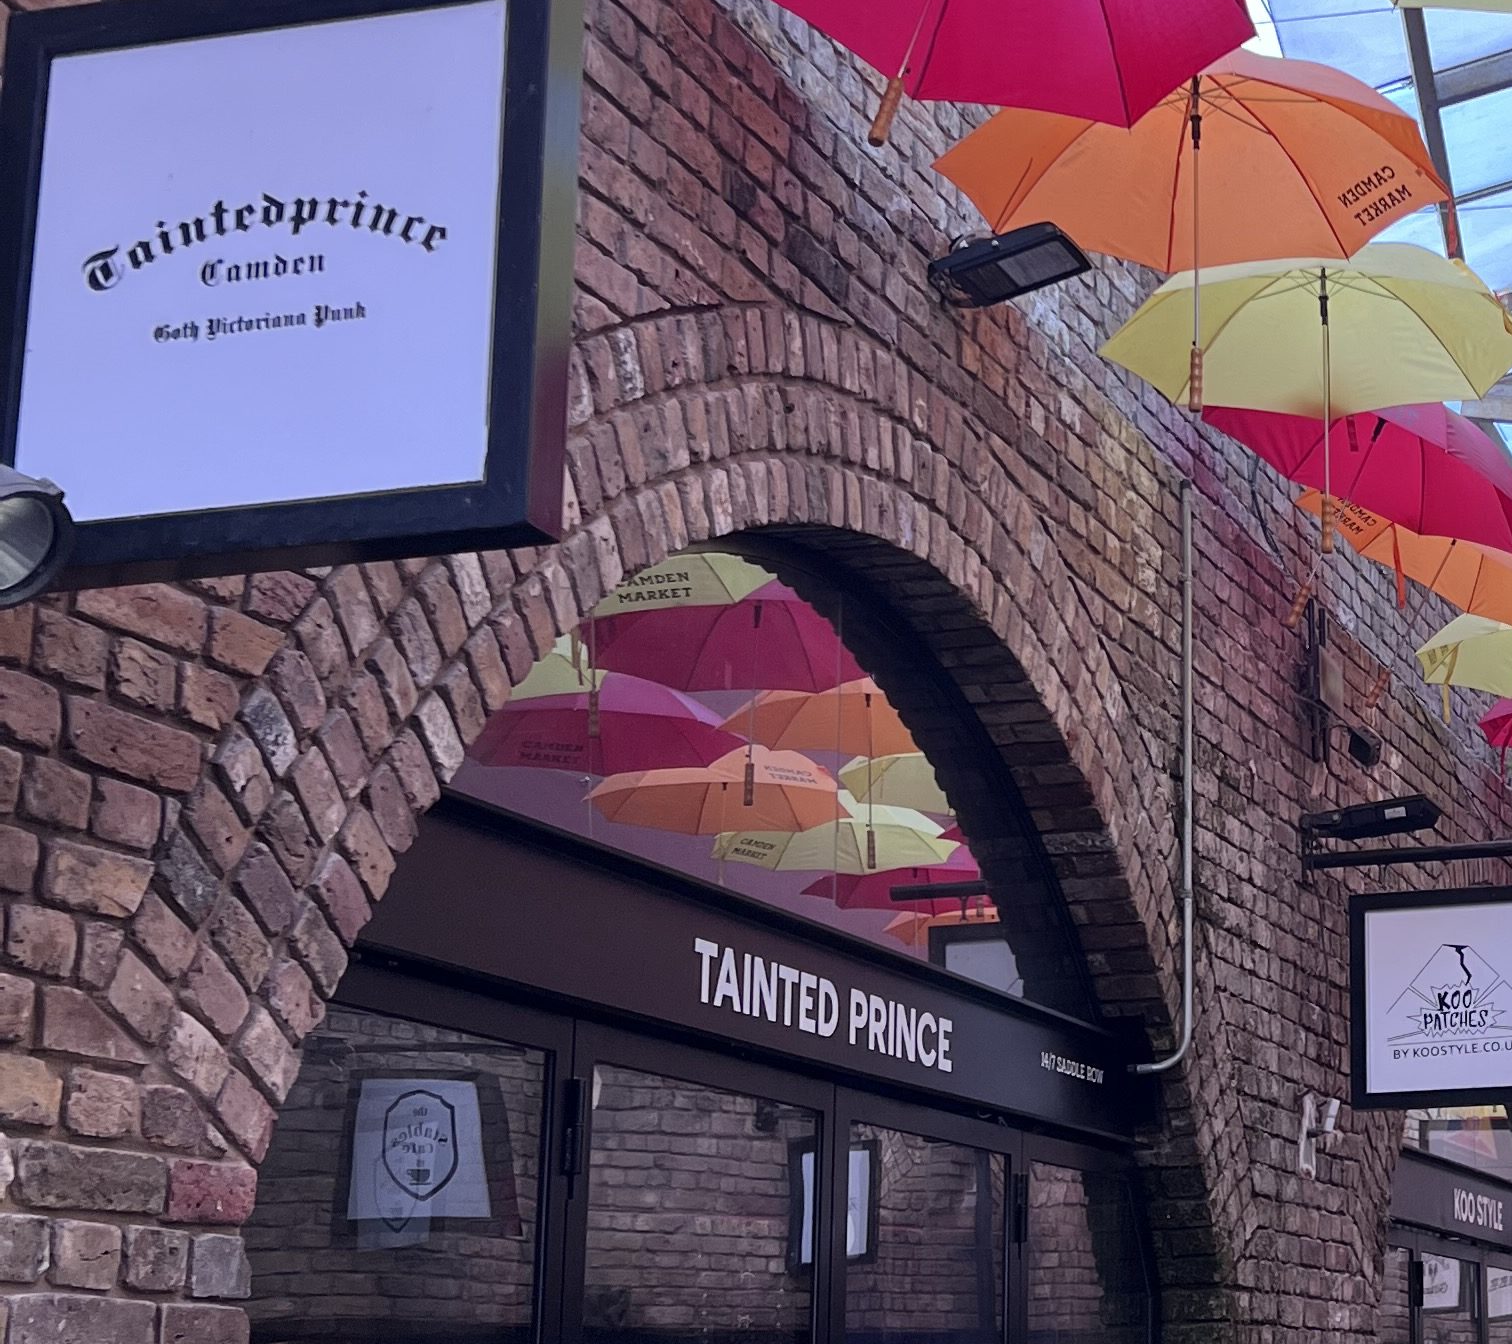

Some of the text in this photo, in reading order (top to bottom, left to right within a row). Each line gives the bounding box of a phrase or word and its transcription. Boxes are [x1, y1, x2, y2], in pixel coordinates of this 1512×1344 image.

[82, 189, 448, 292] Taintedprince
[200, 254, 326, 287] Camden
[153, 322, 199, 343] Goth
[315, 302, 367, 328] Punk
[617, 587, 692, 603] MARKET
[694, 937, 953, 1072] TAINTED PRINCE
[1436, 989, 1472, 1011] KOO
[1423, 1009, 1488, 1031] PATCHES
[1393, 1049, 1409, 1060] BY
[1454, 1188, 1503, 1231] KOO STYLE
